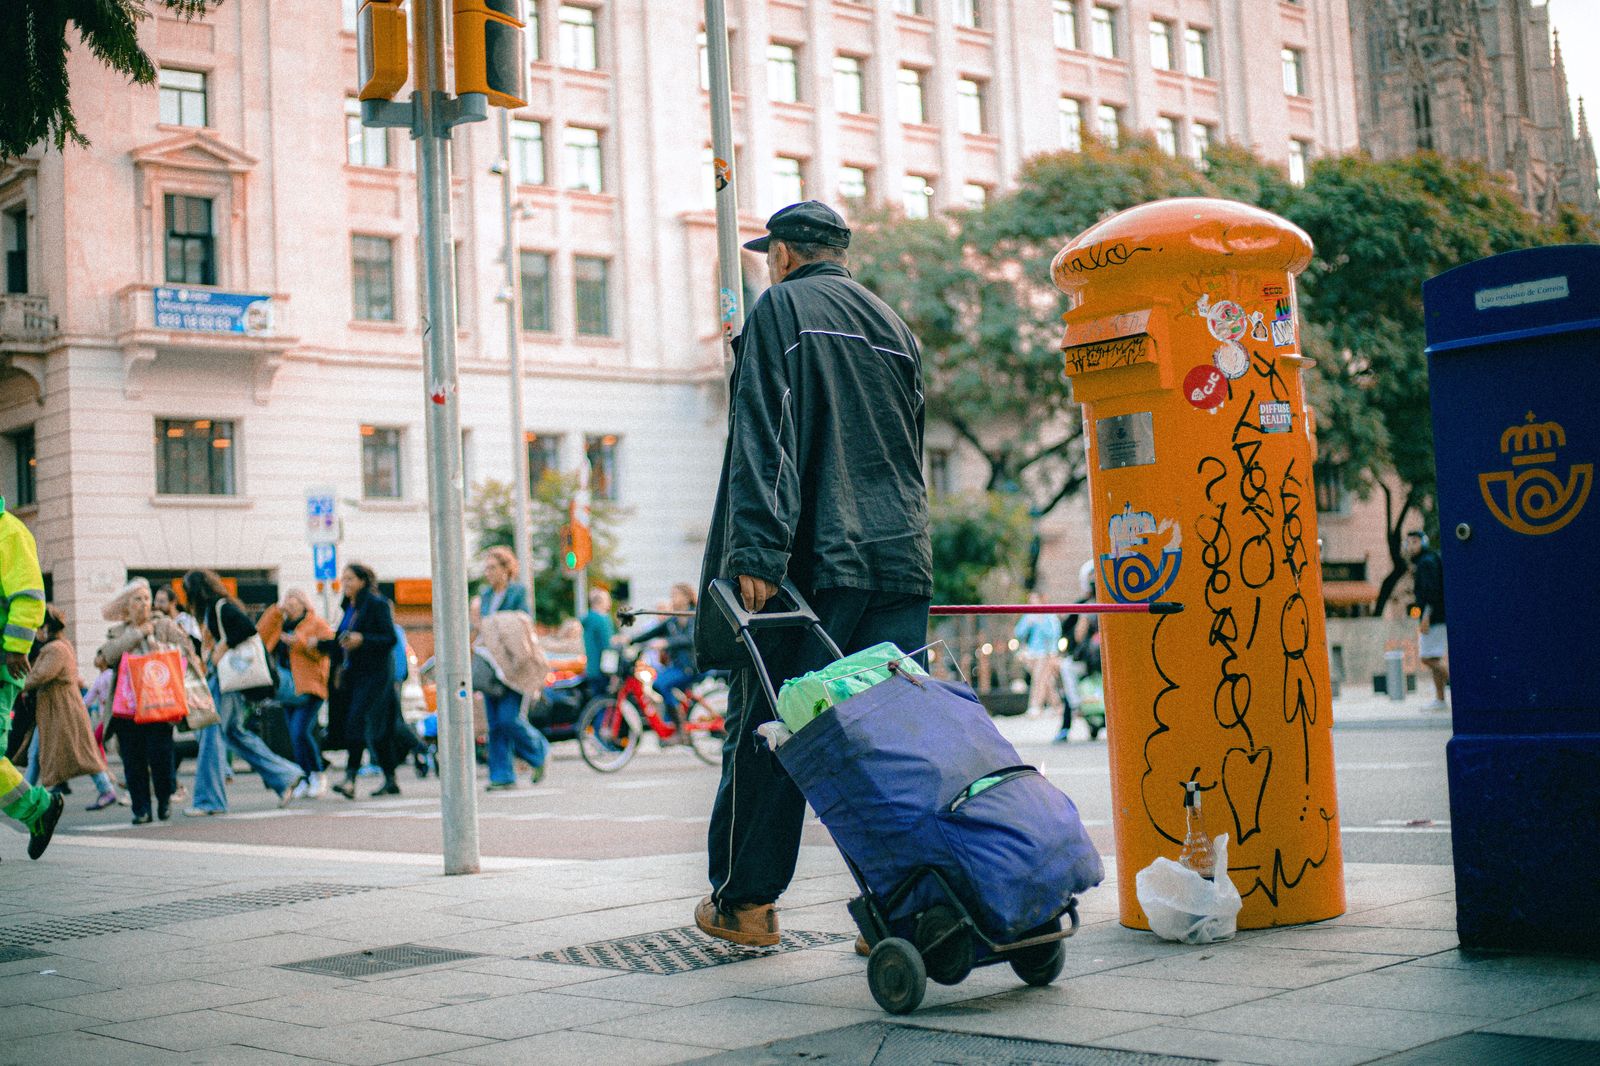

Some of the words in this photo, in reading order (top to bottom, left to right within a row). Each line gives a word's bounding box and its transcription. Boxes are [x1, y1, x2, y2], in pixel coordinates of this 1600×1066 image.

[1495, 290, 1525, 300] exclusivo
[1527, 288, 1536, 296] de
[1537, 285, 1565, 295] Correos
[1203, 371, 1221, 395] CJC
[1260, 403, 1290, 414] DIFFUSE
[1260, 414, 1292, 425] REALITY
